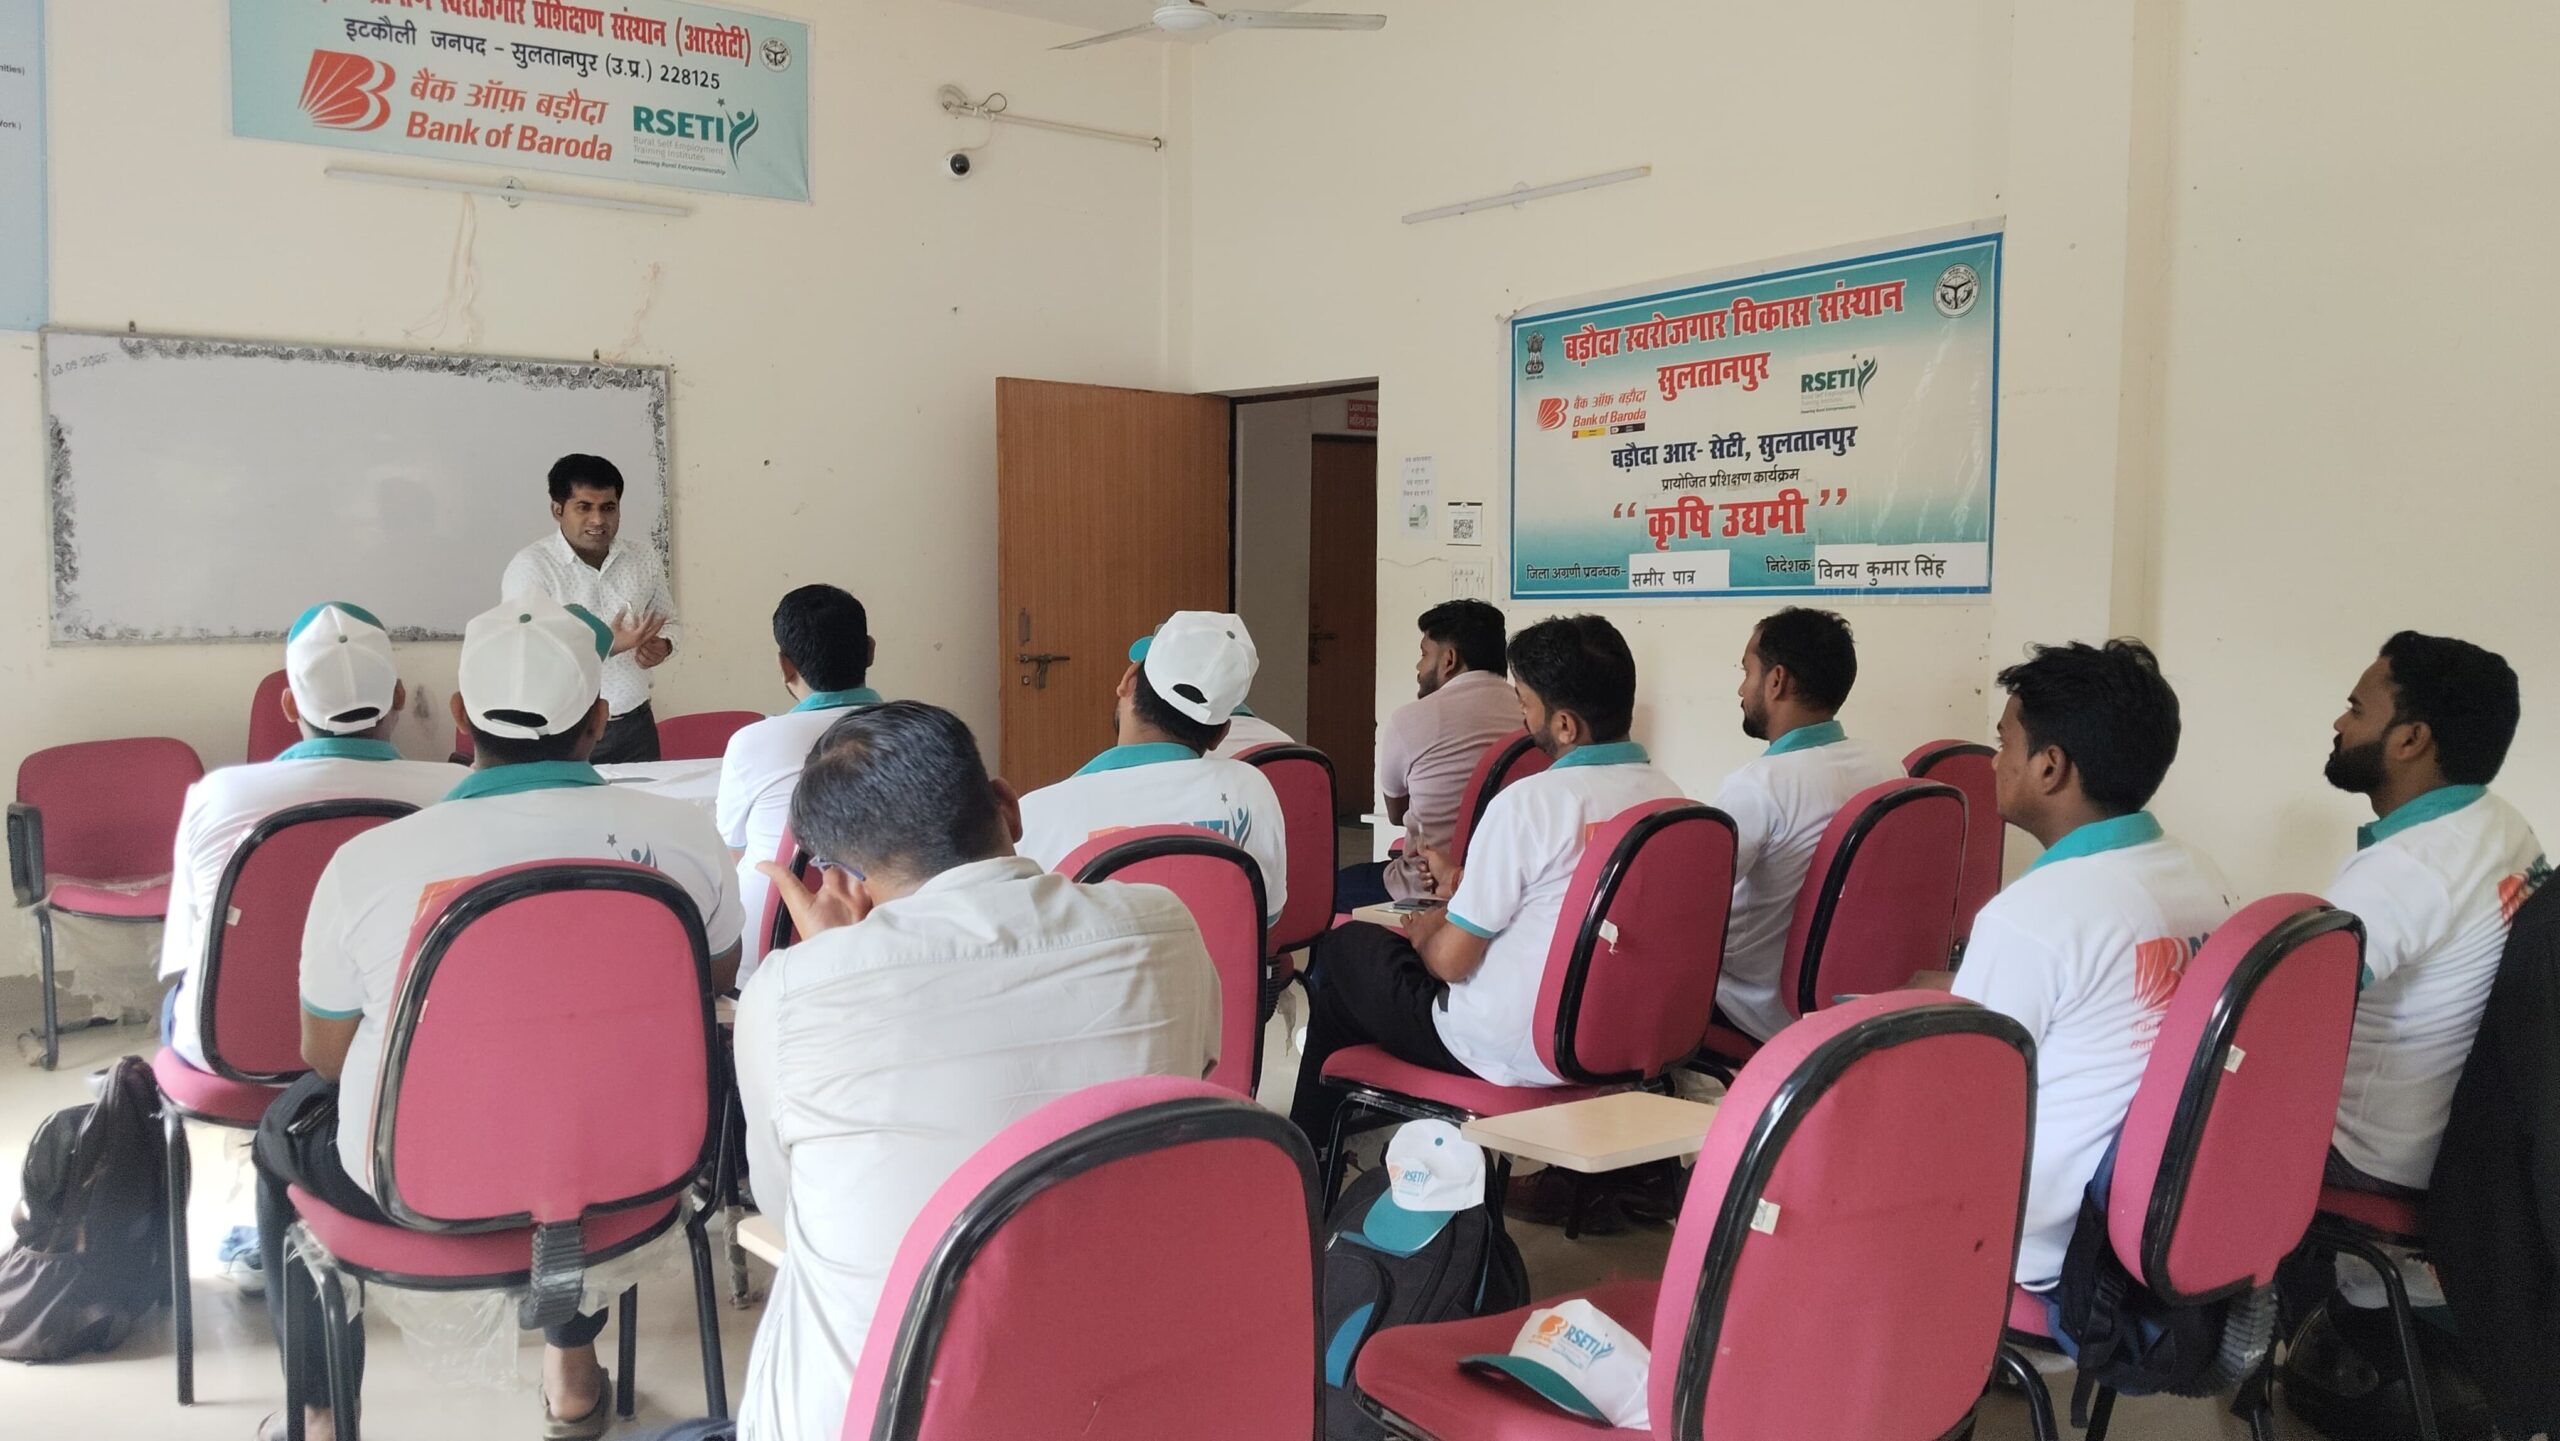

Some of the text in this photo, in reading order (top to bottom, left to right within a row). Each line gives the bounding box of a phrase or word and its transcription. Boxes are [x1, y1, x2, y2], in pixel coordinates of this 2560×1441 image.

[344, 15, 417, 45] इटकौली
[430, 30, 487, 55] जनपद
[511, 42, 598, 77] सुलतानपुर
[660, 64, 720, 90] 228125
[611, 6, 667, 47] संस्थान
[675, 17, 751, 66] (आरसेटी)
[410, 68, 458, 102] बैंक
[536, 88, 609, 125] बड़ौदा
[406, 110, 613, 162] Bank of Baroda
[633, 105, 724, 143] RSETI
[1564, 324, 1621, 367] बड़ौदा
[1625, 312, 1729, 352] स्वरोजगार
[1731, 297, 1813, 336] विकास
[1817, 281, 1906, 323] संस्थान
[1656, 352, 1771, 401] सुलतानपुर
[1801, 368, 1856, 393] RSETI
[1572, 408, 1647, 427] Bank of Baroda
[1611, 442, 1658, 473] बड़ौदा
[1758, 426, 1858, 463] सुलतानपुर
[1661, 464, 1800, 491] प्रायोजित प्रशिक्षण कार्यक्रम
[1645, 495, 1714, 551] कृषि
[1719, 488, 1809, 537] उद्यमी
[1526, 565, 1550, 582] जिला
[1551, 562, 1581, 581] अग्रणी
[1632, 567, 1665, 588] समीर
[1672, 569, 1697, 586] पात्र
[1818, 559, 1860, 580] विनय
[1866, 559, 1911, 586] कुमार
[1914, 553, 1948, 579] सिंह
[1564, 1324, 1601, 1355] RSETI
